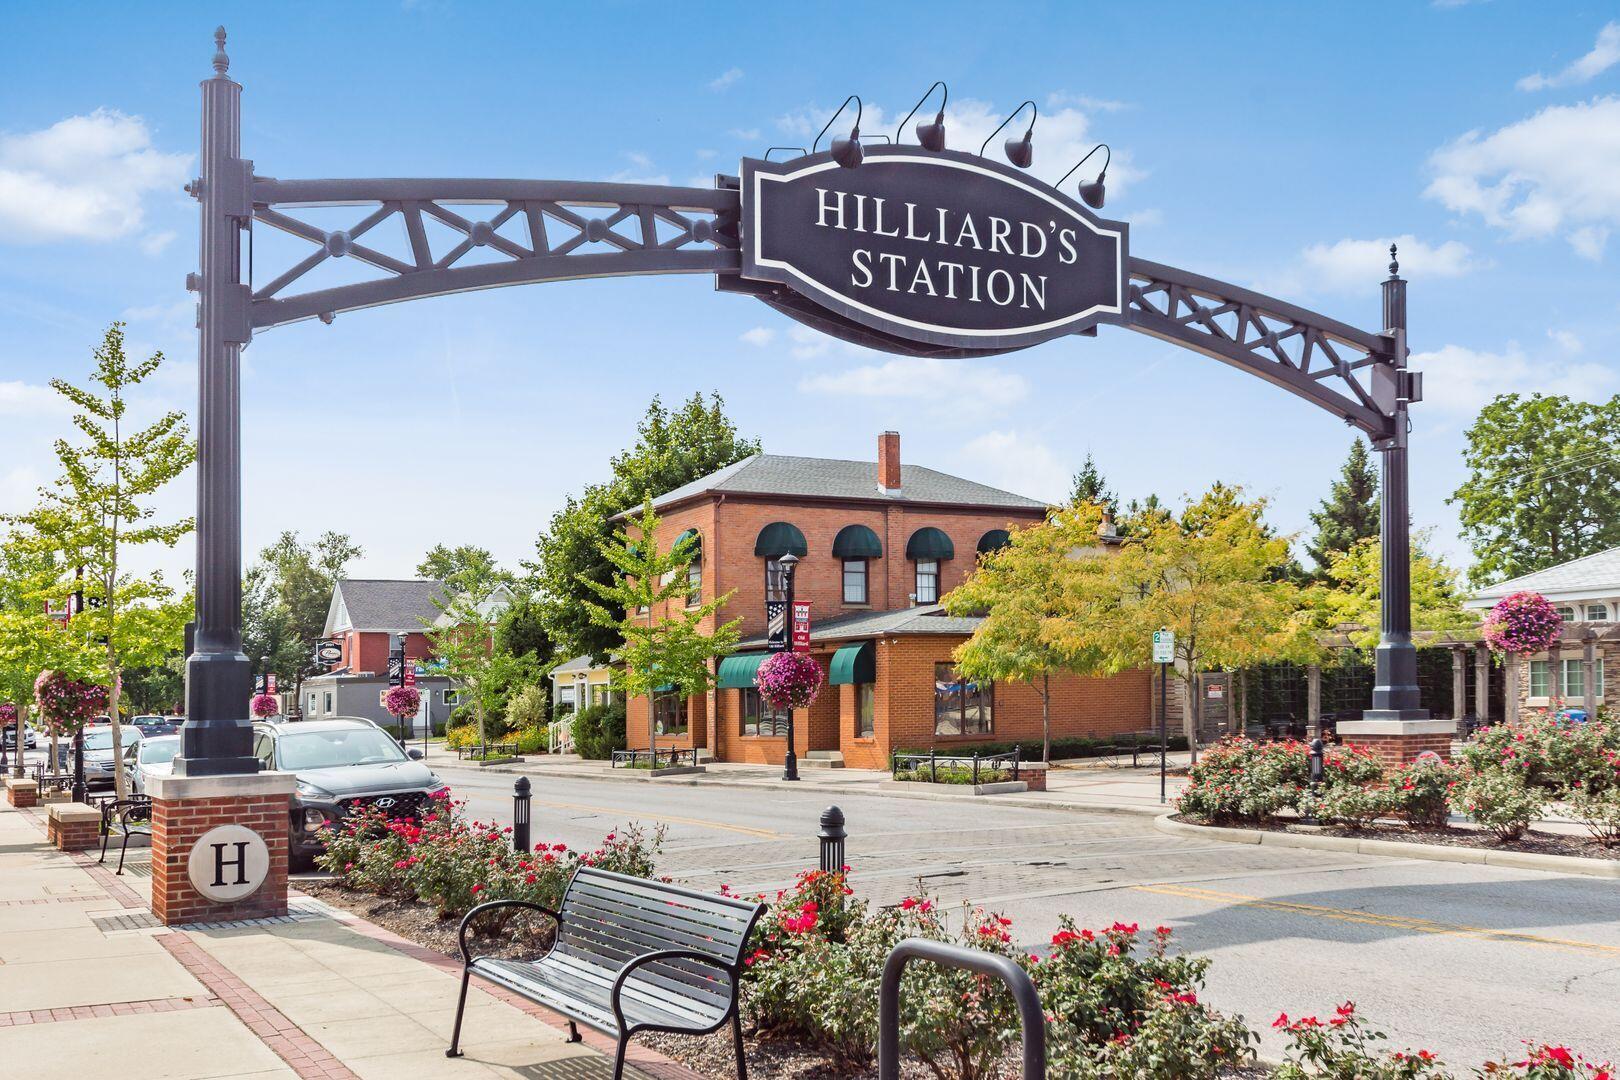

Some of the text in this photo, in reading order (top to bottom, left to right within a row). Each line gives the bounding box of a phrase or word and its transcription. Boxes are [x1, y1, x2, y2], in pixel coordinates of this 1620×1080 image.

[815, 188, 1078, 265] HILLIARD'S
[851, 248, 1048, 311] STATION
[210, 842, 250, 887] H
